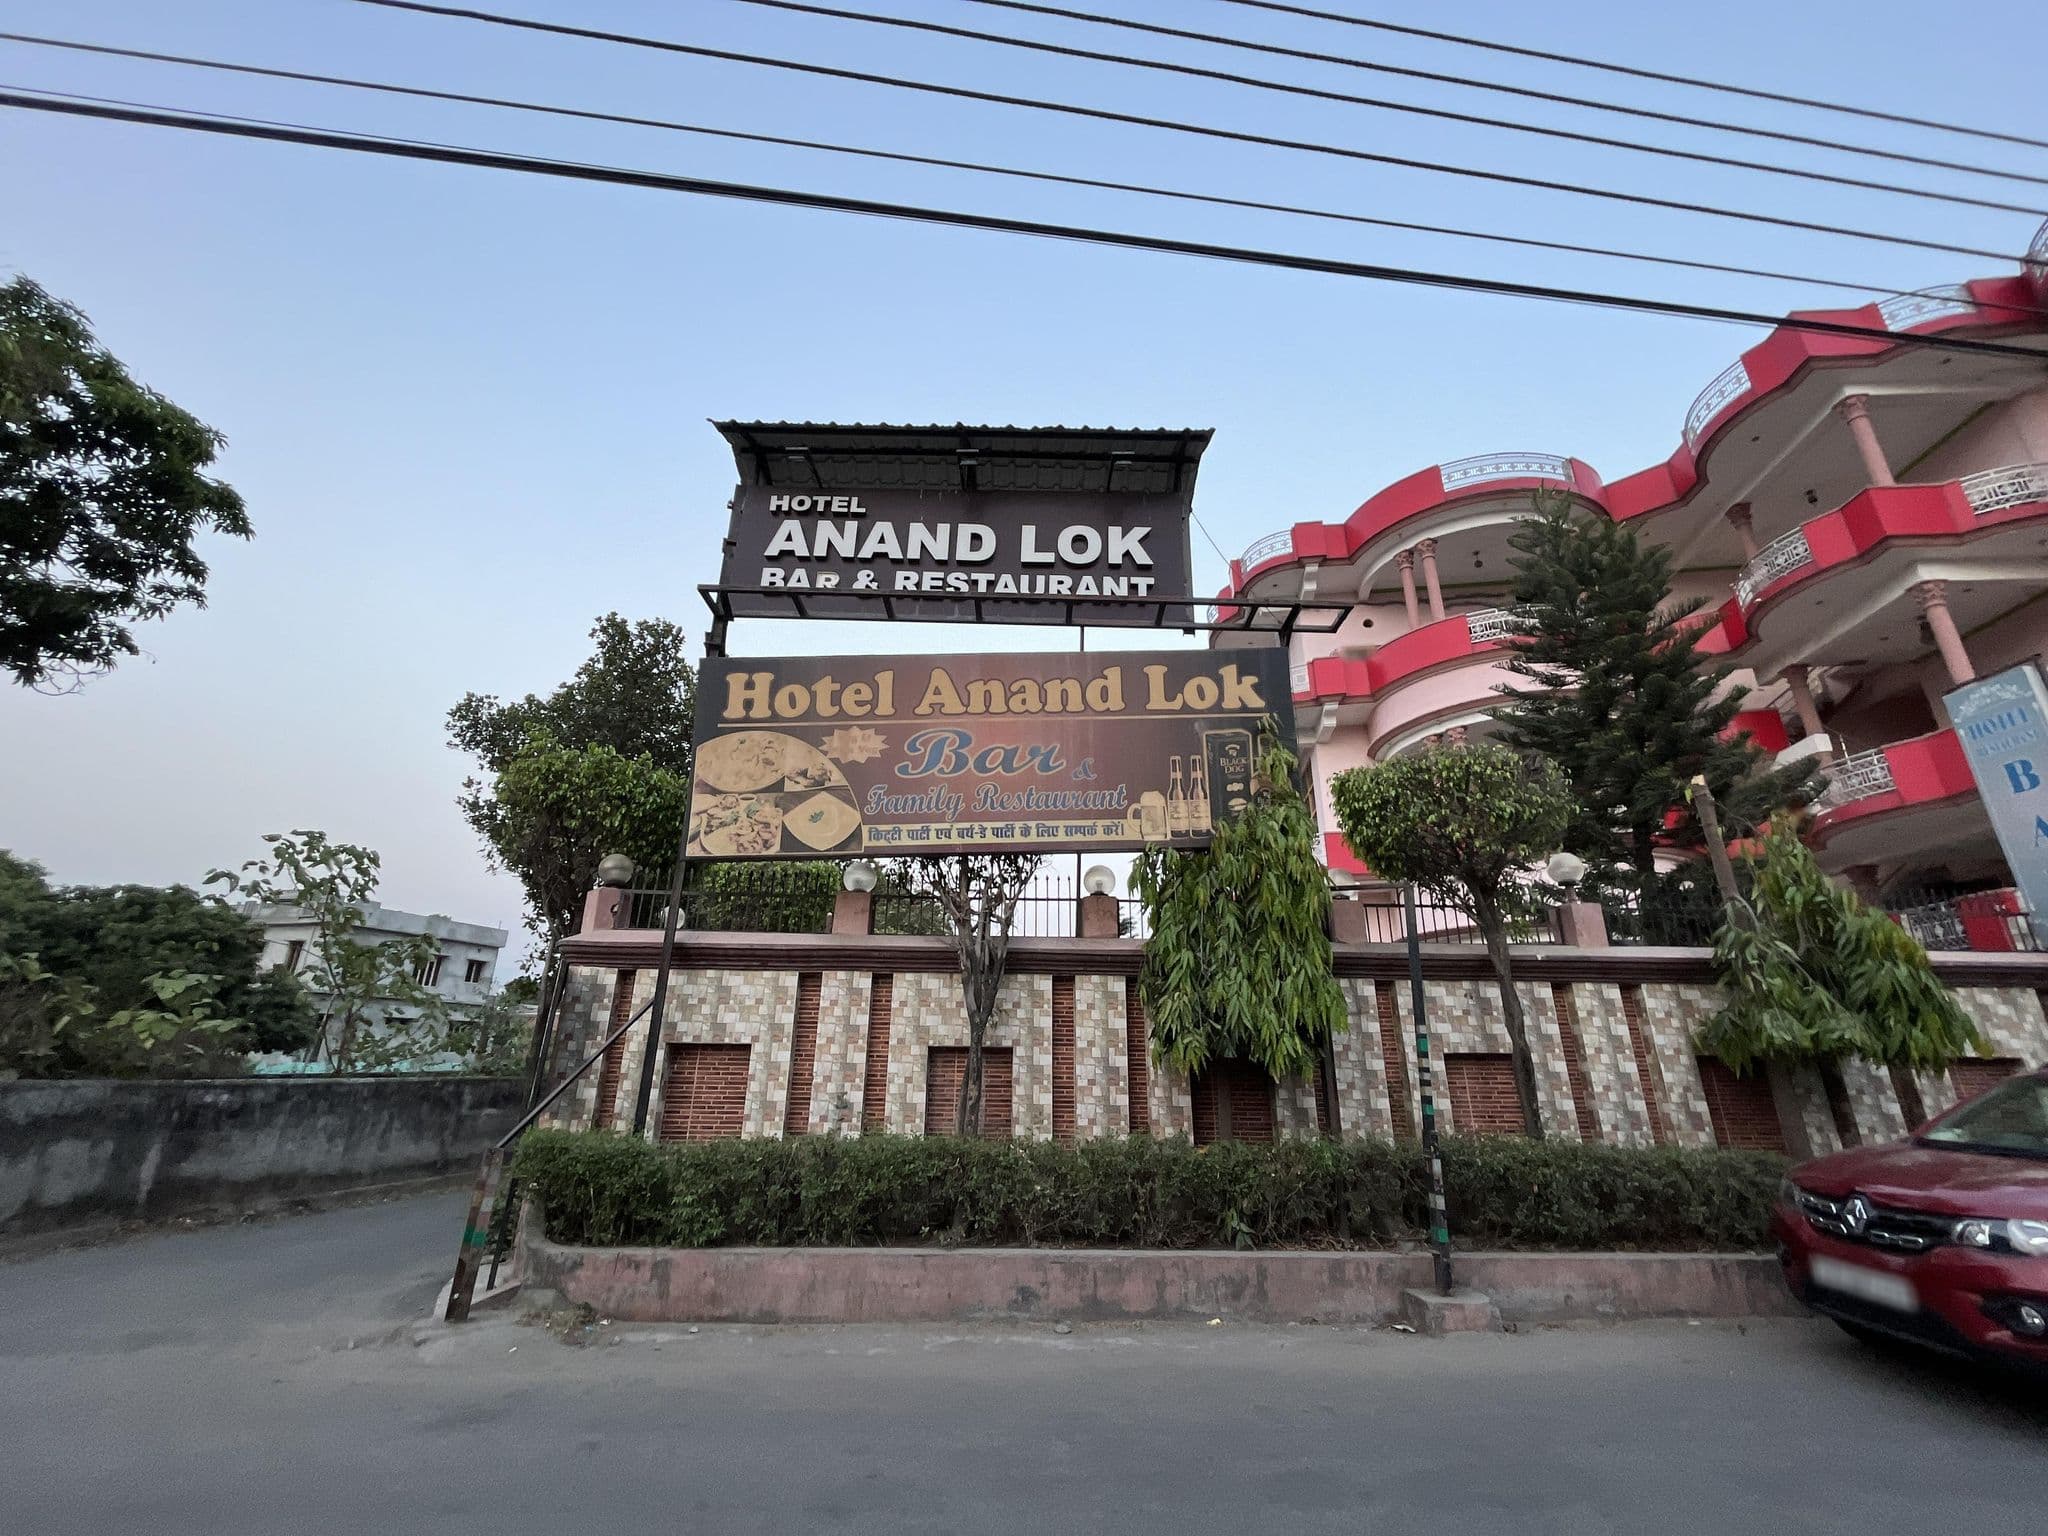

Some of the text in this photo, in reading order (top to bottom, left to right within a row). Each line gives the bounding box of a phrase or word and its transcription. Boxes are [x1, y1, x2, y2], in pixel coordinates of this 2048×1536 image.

[769, 494, 867, 513] HOTEL
[763, 519, 1155, 566] ANAND LOK
[760, 567, 1155, 597] BAR & RESTAURANT
[722, 663, 1266, 719] Hotel Anand Lok
[894, 727, 1067, 778] Bar
[1071, 757, 1098, 781] &
[864, 784, 966, 821] Family
[971, 781, 1128, 817] Restaurant
[935, 824, 952, 840] एवं
[1019, 823, 1032, 838] के
[1036, 822, 1060, 838] लिए
